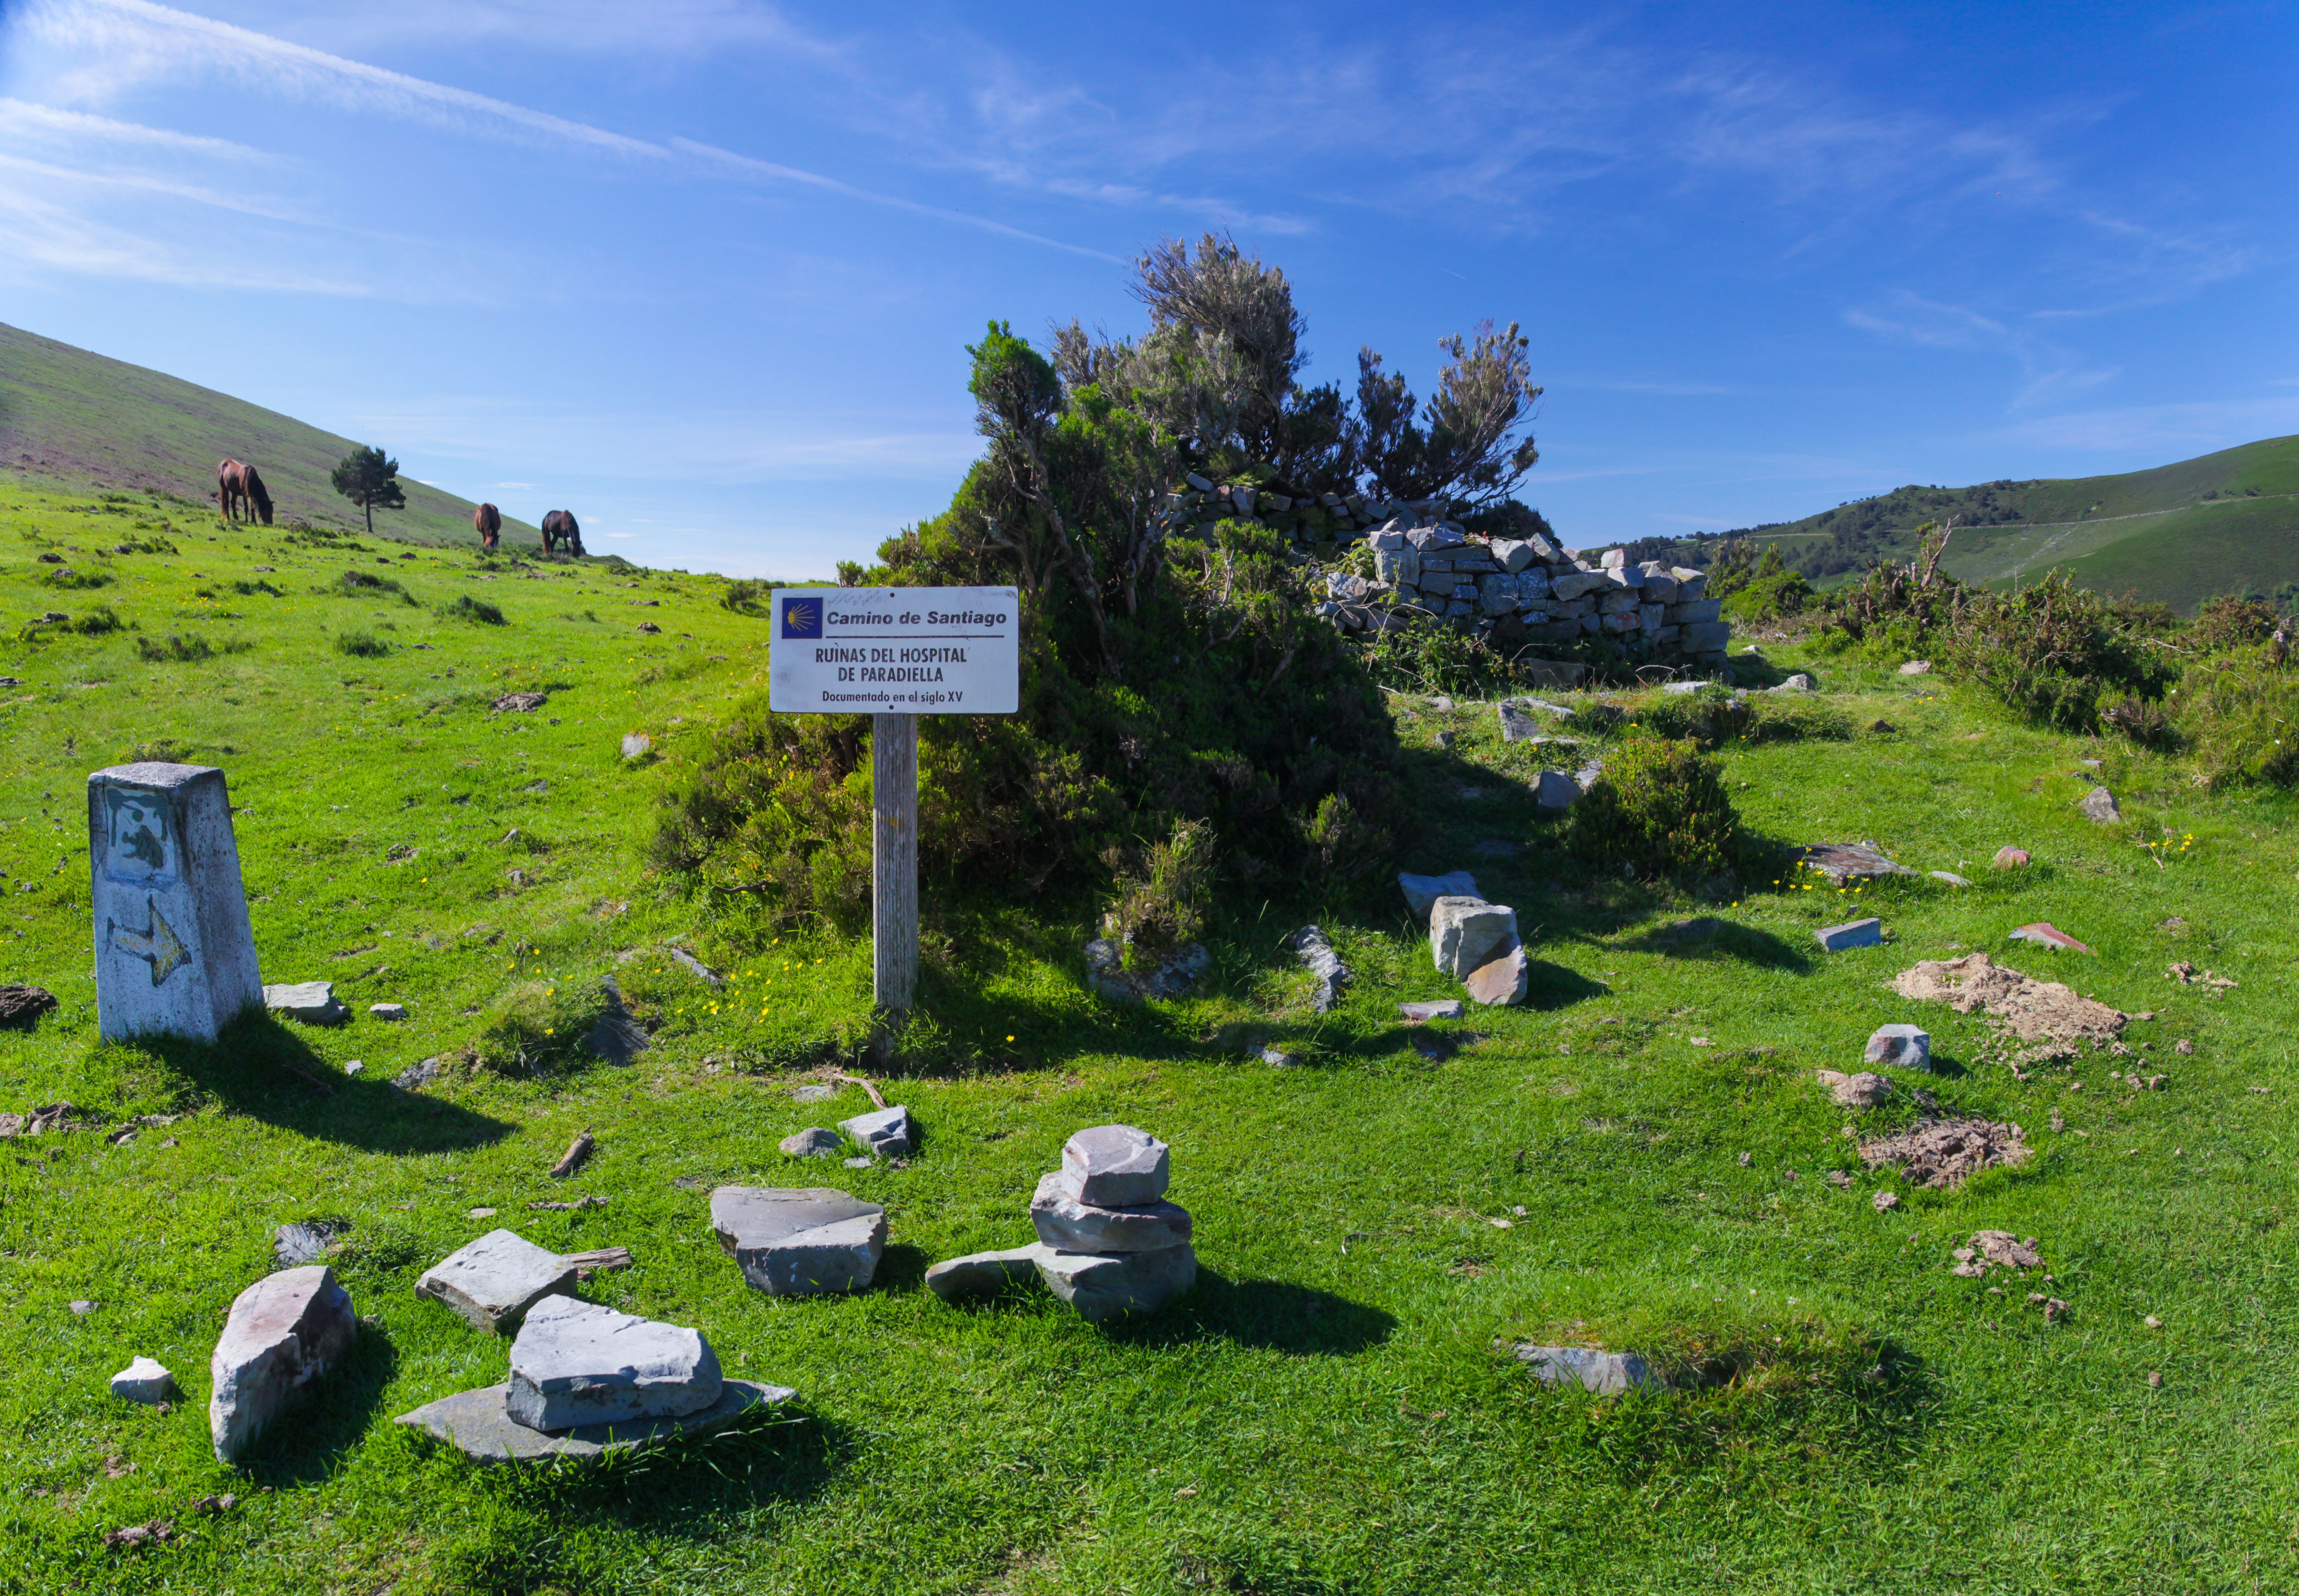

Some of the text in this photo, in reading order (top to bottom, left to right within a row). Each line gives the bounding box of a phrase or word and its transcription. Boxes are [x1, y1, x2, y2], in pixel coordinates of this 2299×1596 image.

[827, 610, 1007, 627] Camino de Santiago
[815, 648, 967, 663] RUINAS DEL HOSPITAL
[838, 667, 943, 682] DE PARADIELLA
[822, 690, 890, 702] Documentado
[908, 690, 917, 702] el
[921, 690, 945, 705] siglo
[948, 691, 963, 702] XV
